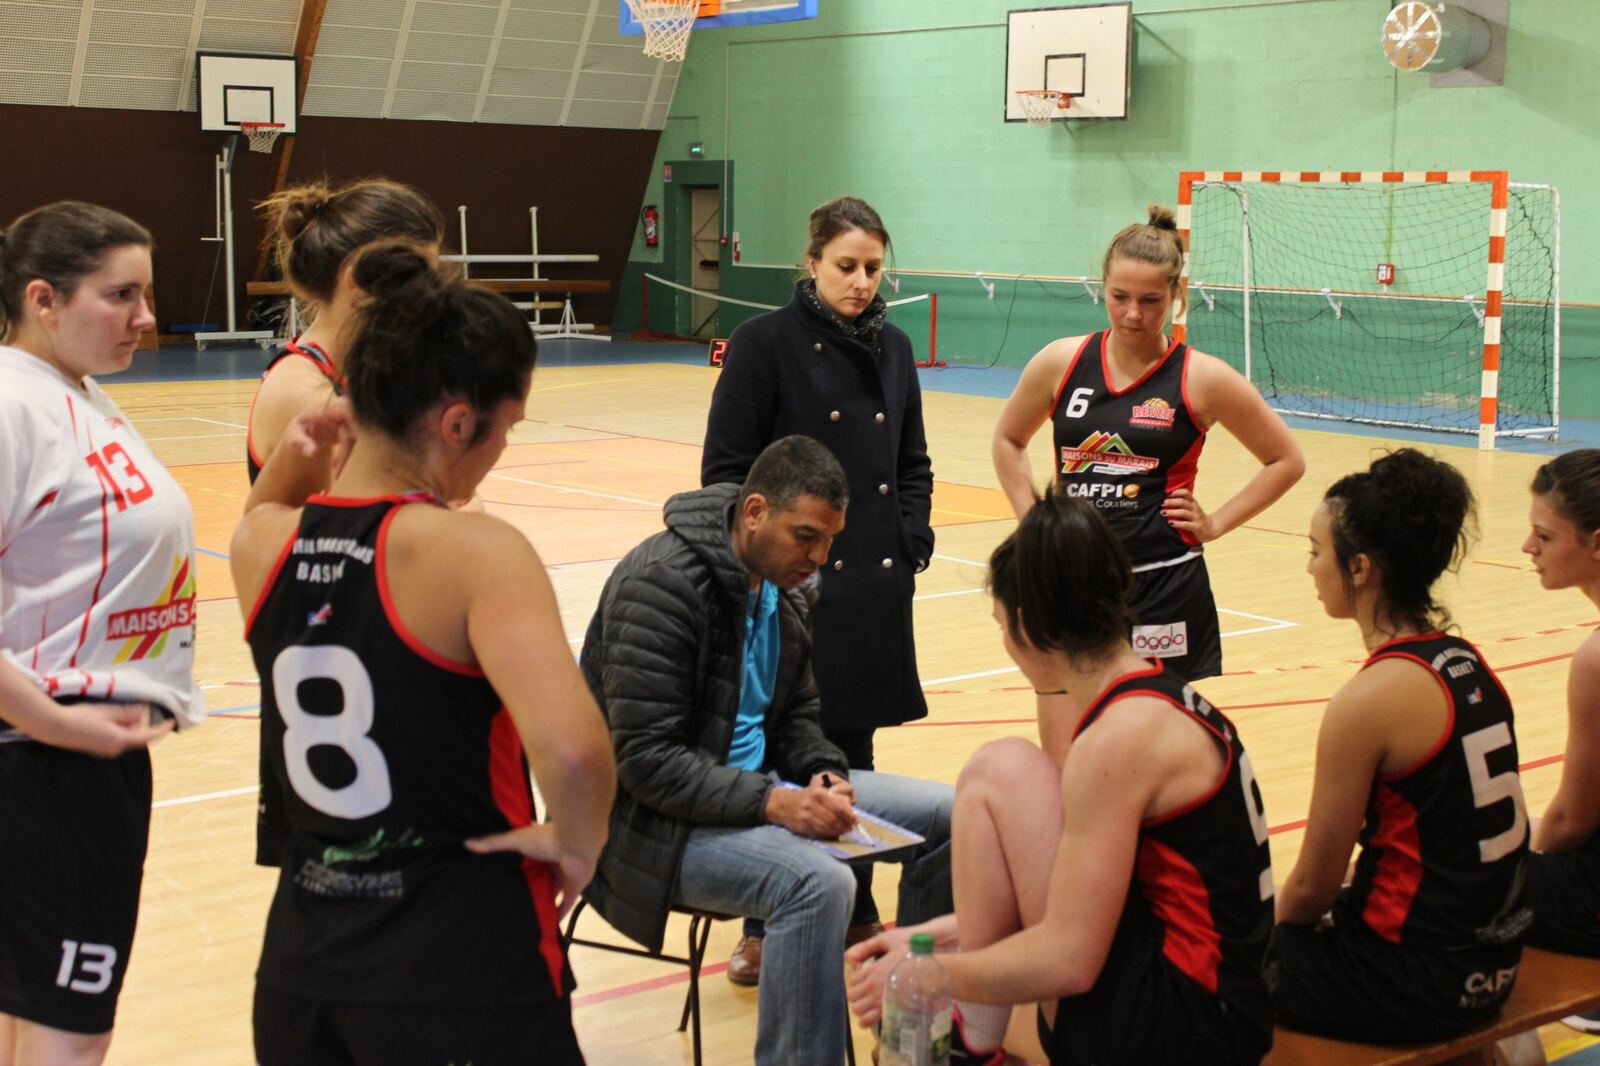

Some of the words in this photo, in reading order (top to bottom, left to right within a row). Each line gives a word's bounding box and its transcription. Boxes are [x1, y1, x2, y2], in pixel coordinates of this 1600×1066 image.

[711, 341, 727, 362] 2
[1066, 388, 1095, 418] 6
[84, 442, 154, 512] 13
[111, 602, 189, 635] MAISONS
[273, 645, 392, 819] 8
[1461, 721, 1530, 863] 5
[56, 939, 118, 995] 13
